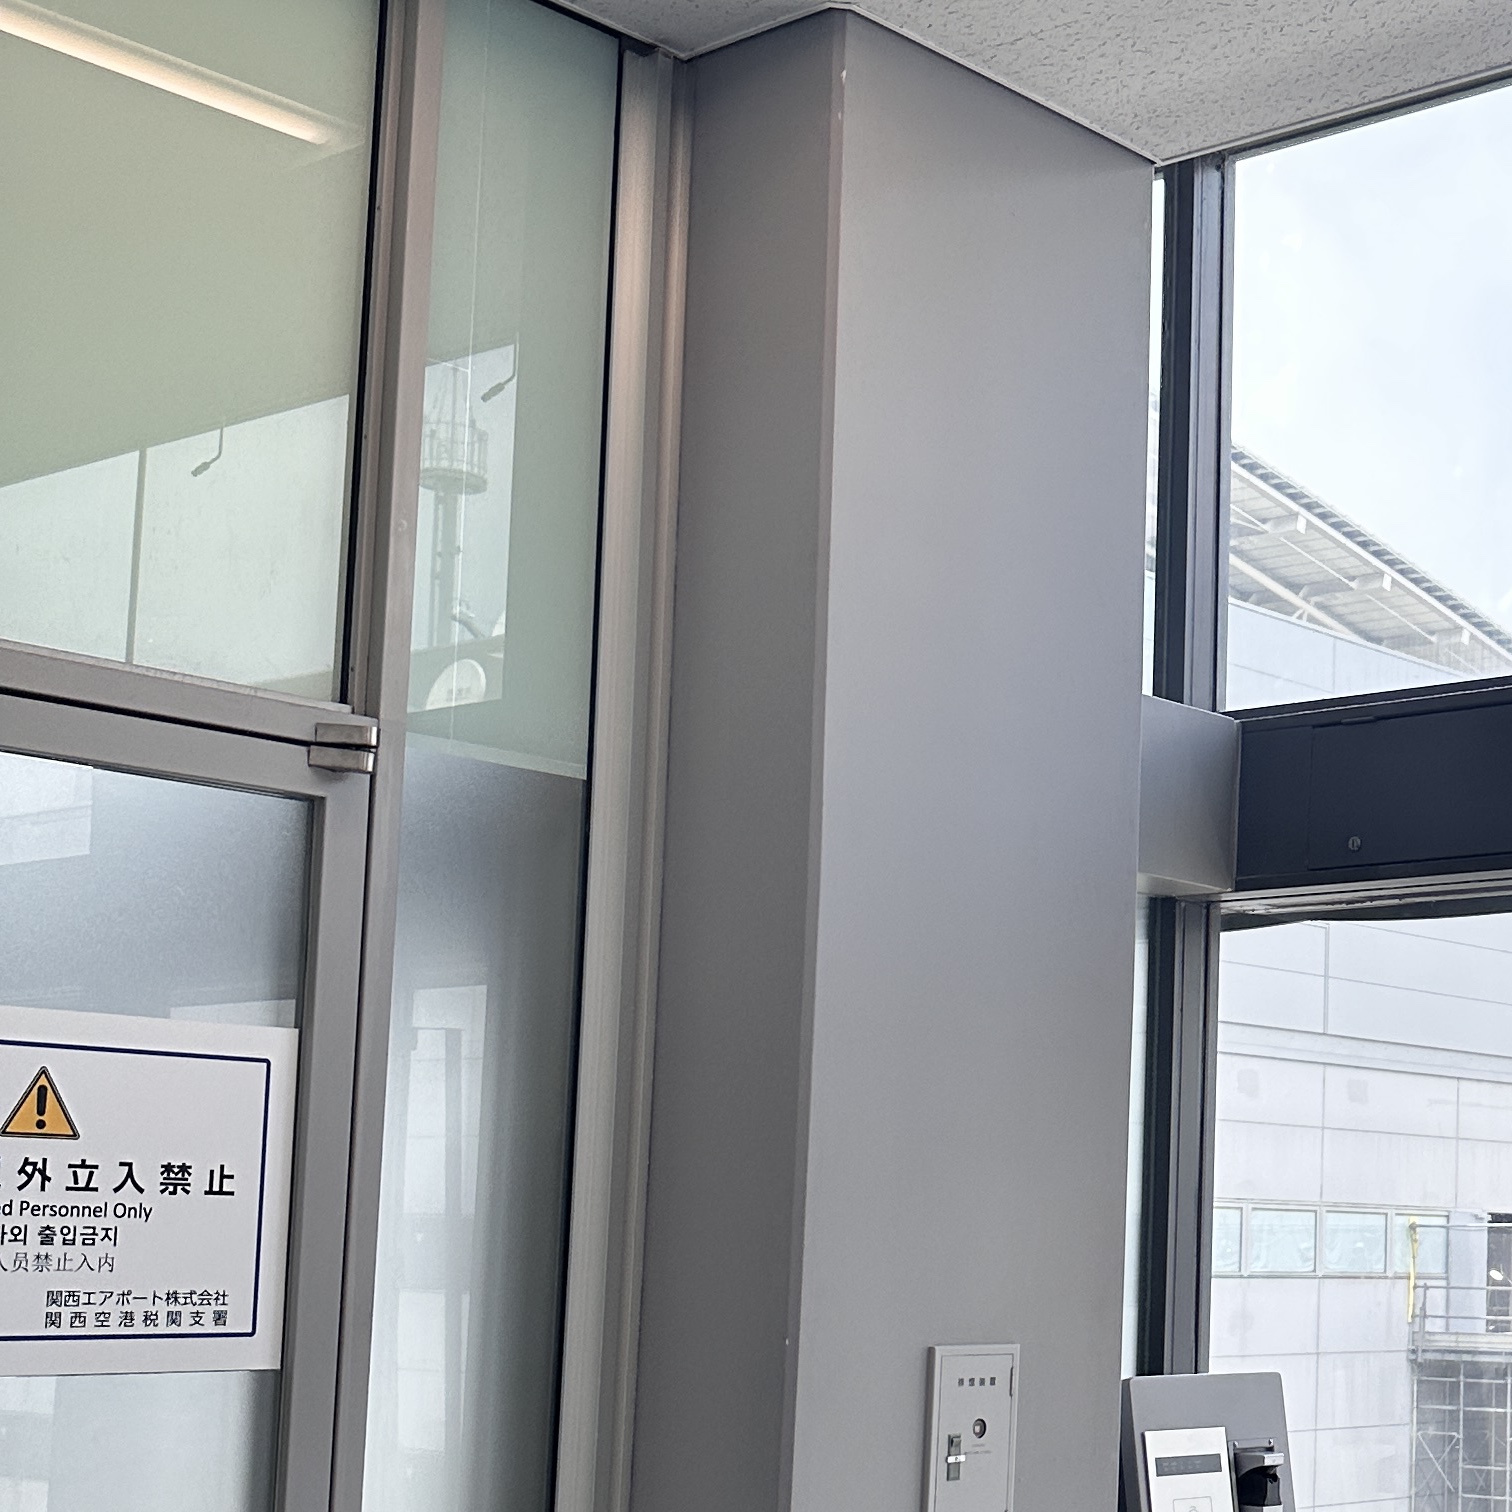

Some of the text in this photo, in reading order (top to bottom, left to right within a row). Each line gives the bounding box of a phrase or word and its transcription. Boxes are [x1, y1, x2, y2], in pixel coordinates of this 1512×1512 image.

[0, 1156, 235, 1196] 外立入禁止
[20, 1200, 108, 1218] Personnel
[113, 1202, 153, 1223] Only
[37, 1224, 118, 1247] 출입금지
[46, 1290, 229, 1308] 関西エアポート株式会社
[45, 1310, 228, 1329] 関西空港税関支署
